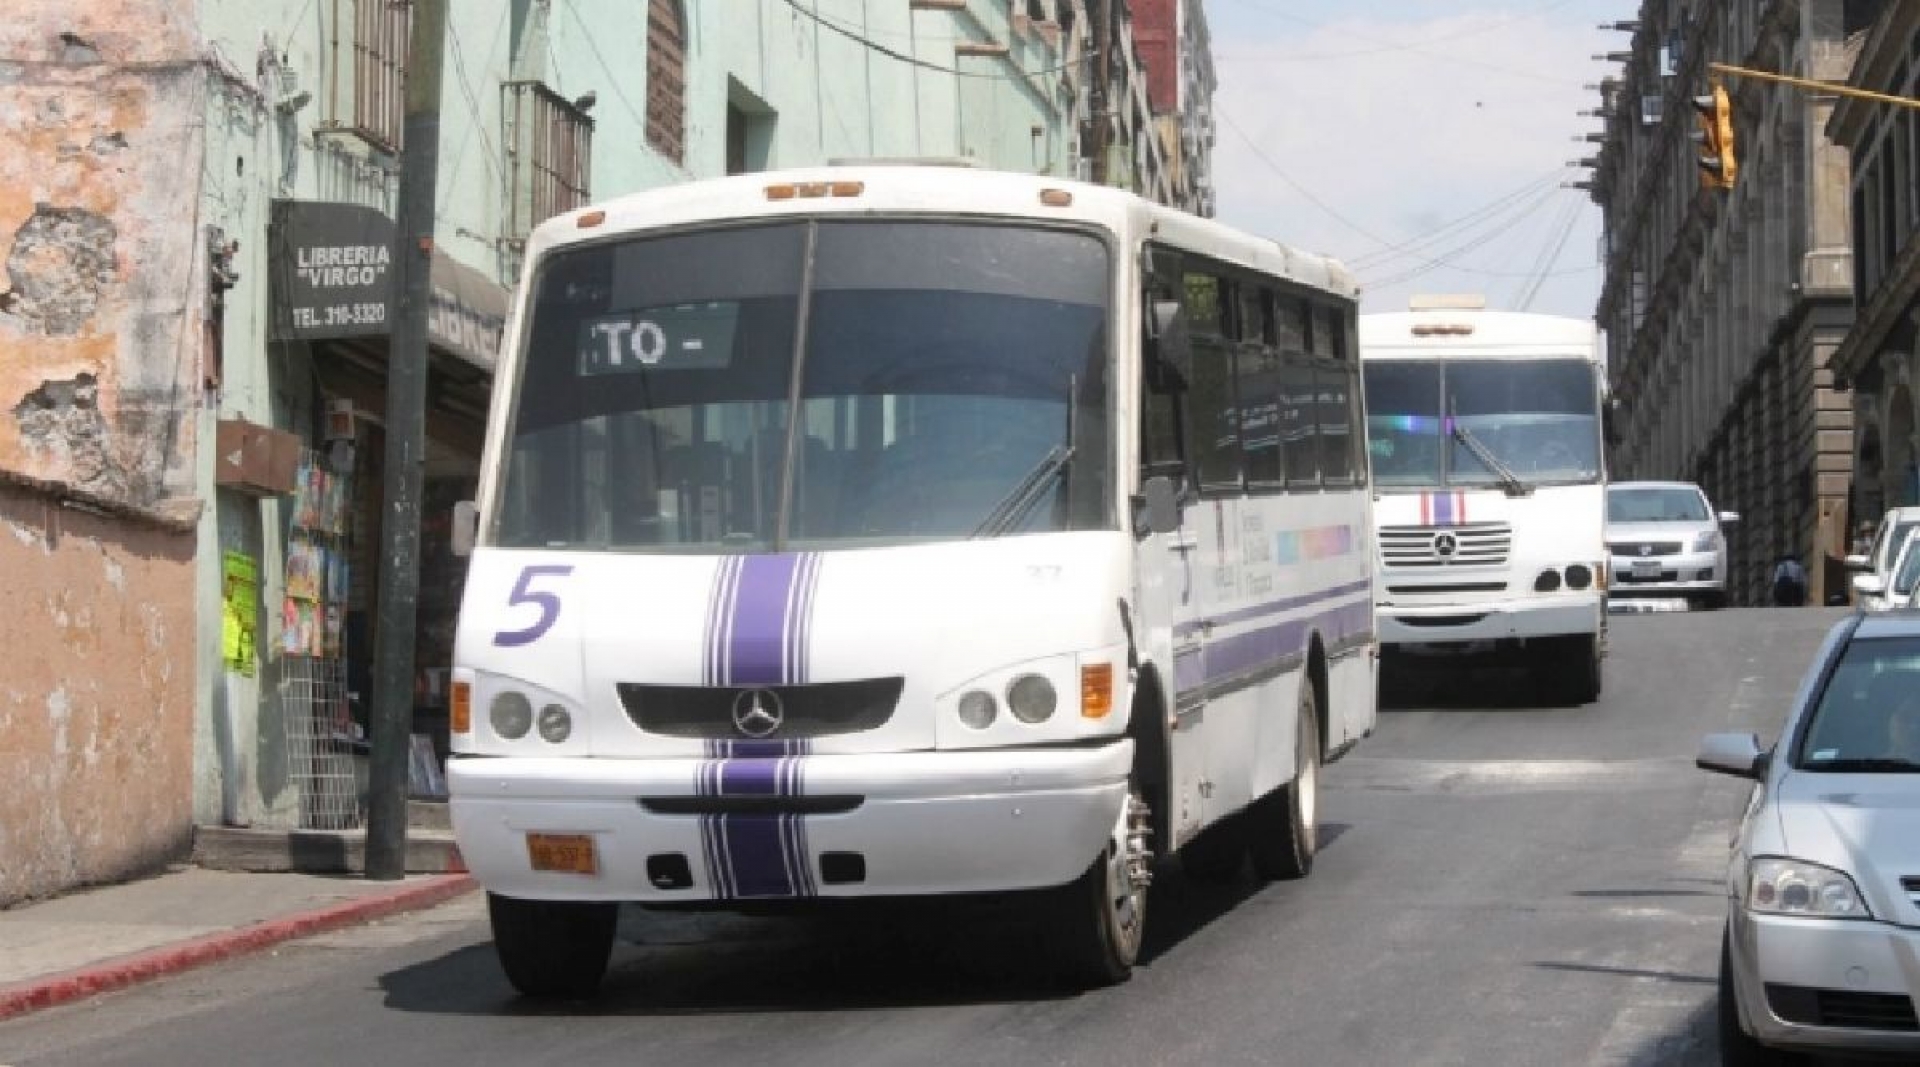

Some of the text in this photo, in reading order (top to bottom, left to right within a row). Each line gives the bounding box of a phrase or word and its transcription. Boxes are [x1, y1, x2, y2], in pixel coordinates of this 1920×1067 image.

[298, 246, 389, 268] LIBRERIA
[297, 266, 385, 287] "VIRGO"
[592, 320, 666, 365] TO
[492, 565, 575, 646] 5
